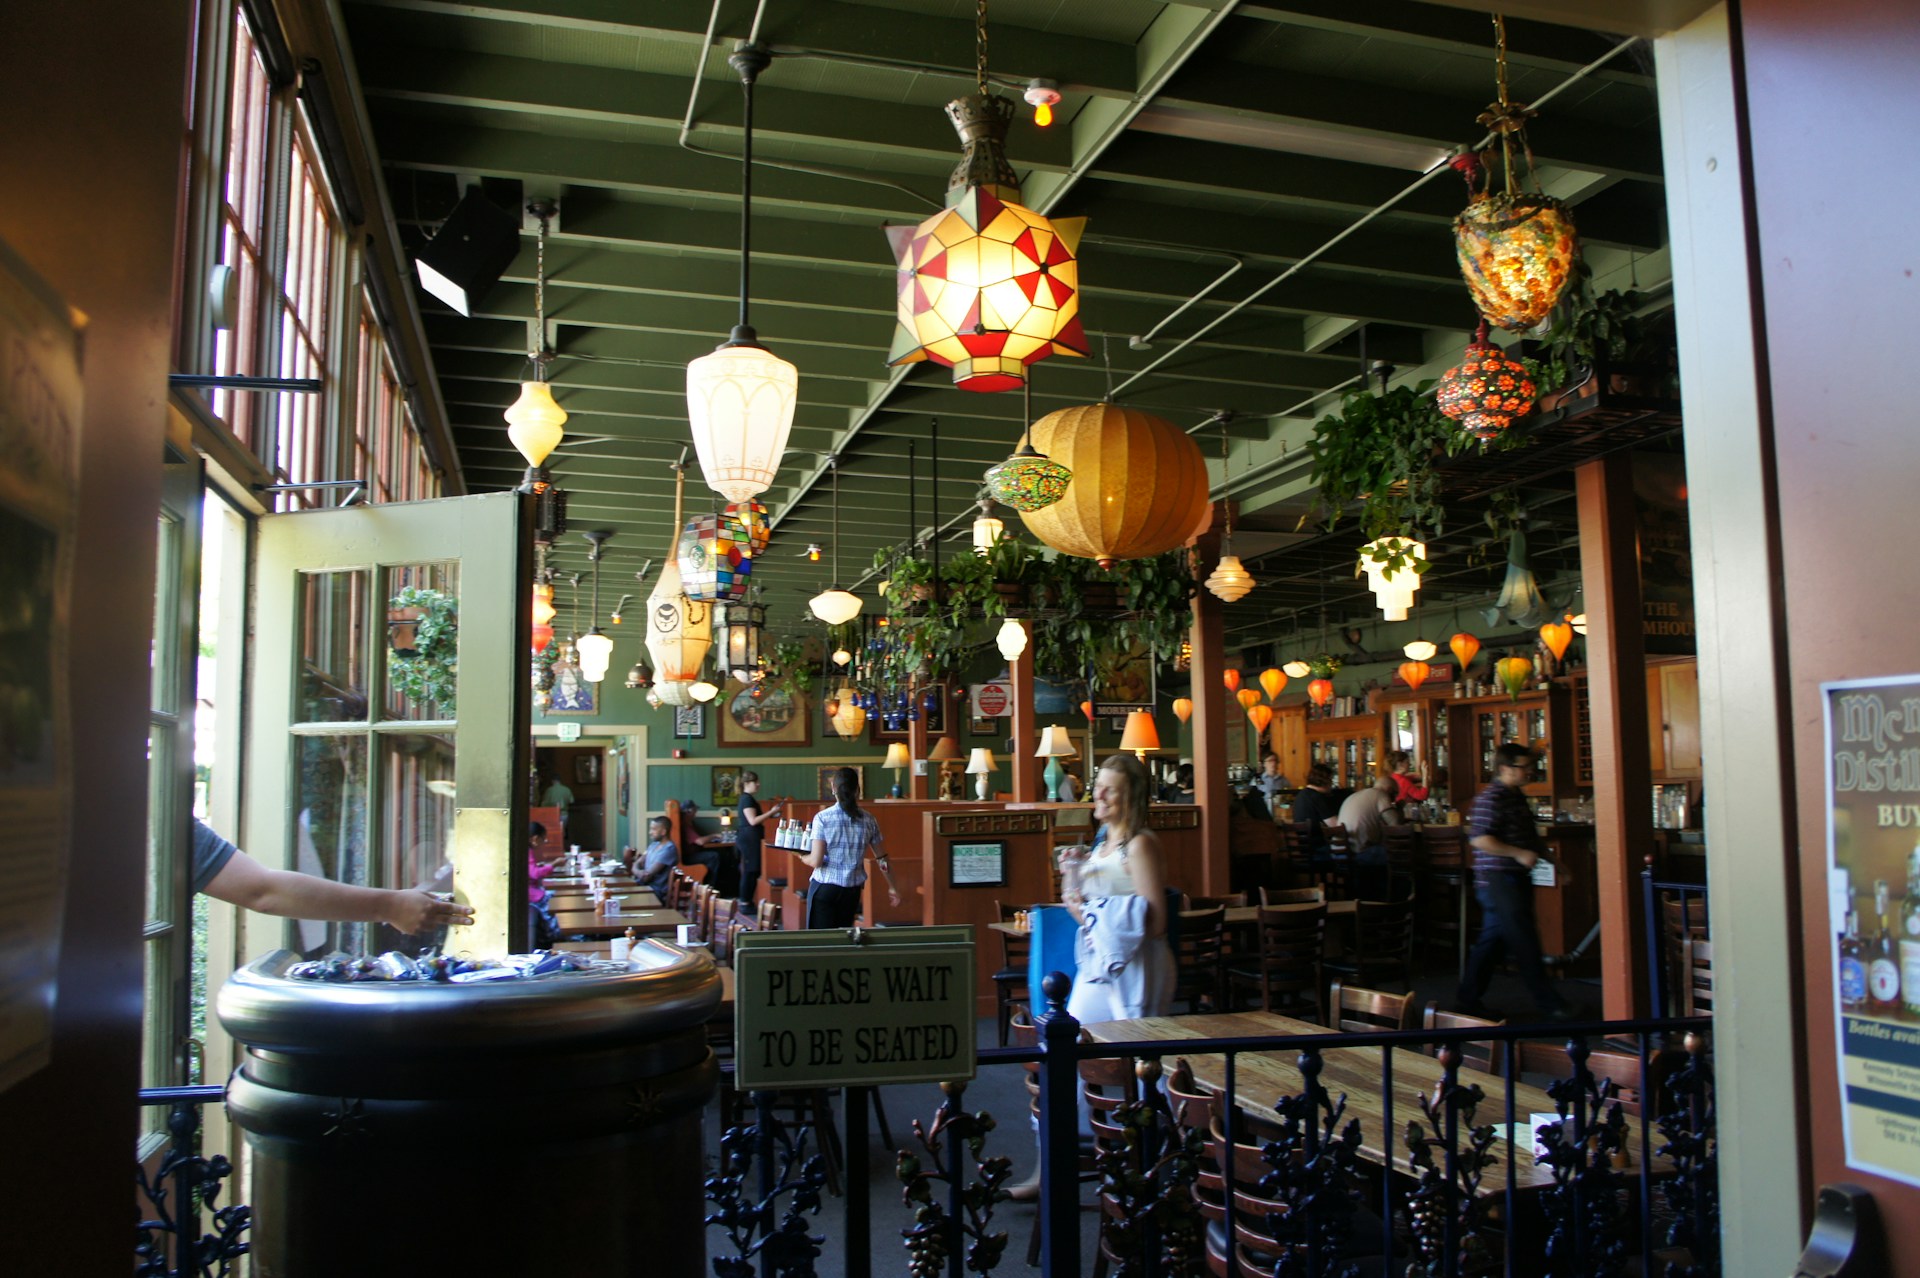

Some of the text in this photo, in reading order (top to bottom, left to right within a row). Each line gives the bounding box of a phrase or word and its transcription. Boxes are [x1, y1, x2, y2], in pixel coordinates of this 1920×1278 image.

[1644, 602, 1679, 616] THE
[767, 965, 953, 1007] PLEASE WAIT
[1849, 1020, 1891, 1040] Bottles
[759, 1024, 958, 1068] TO BE SEATED
